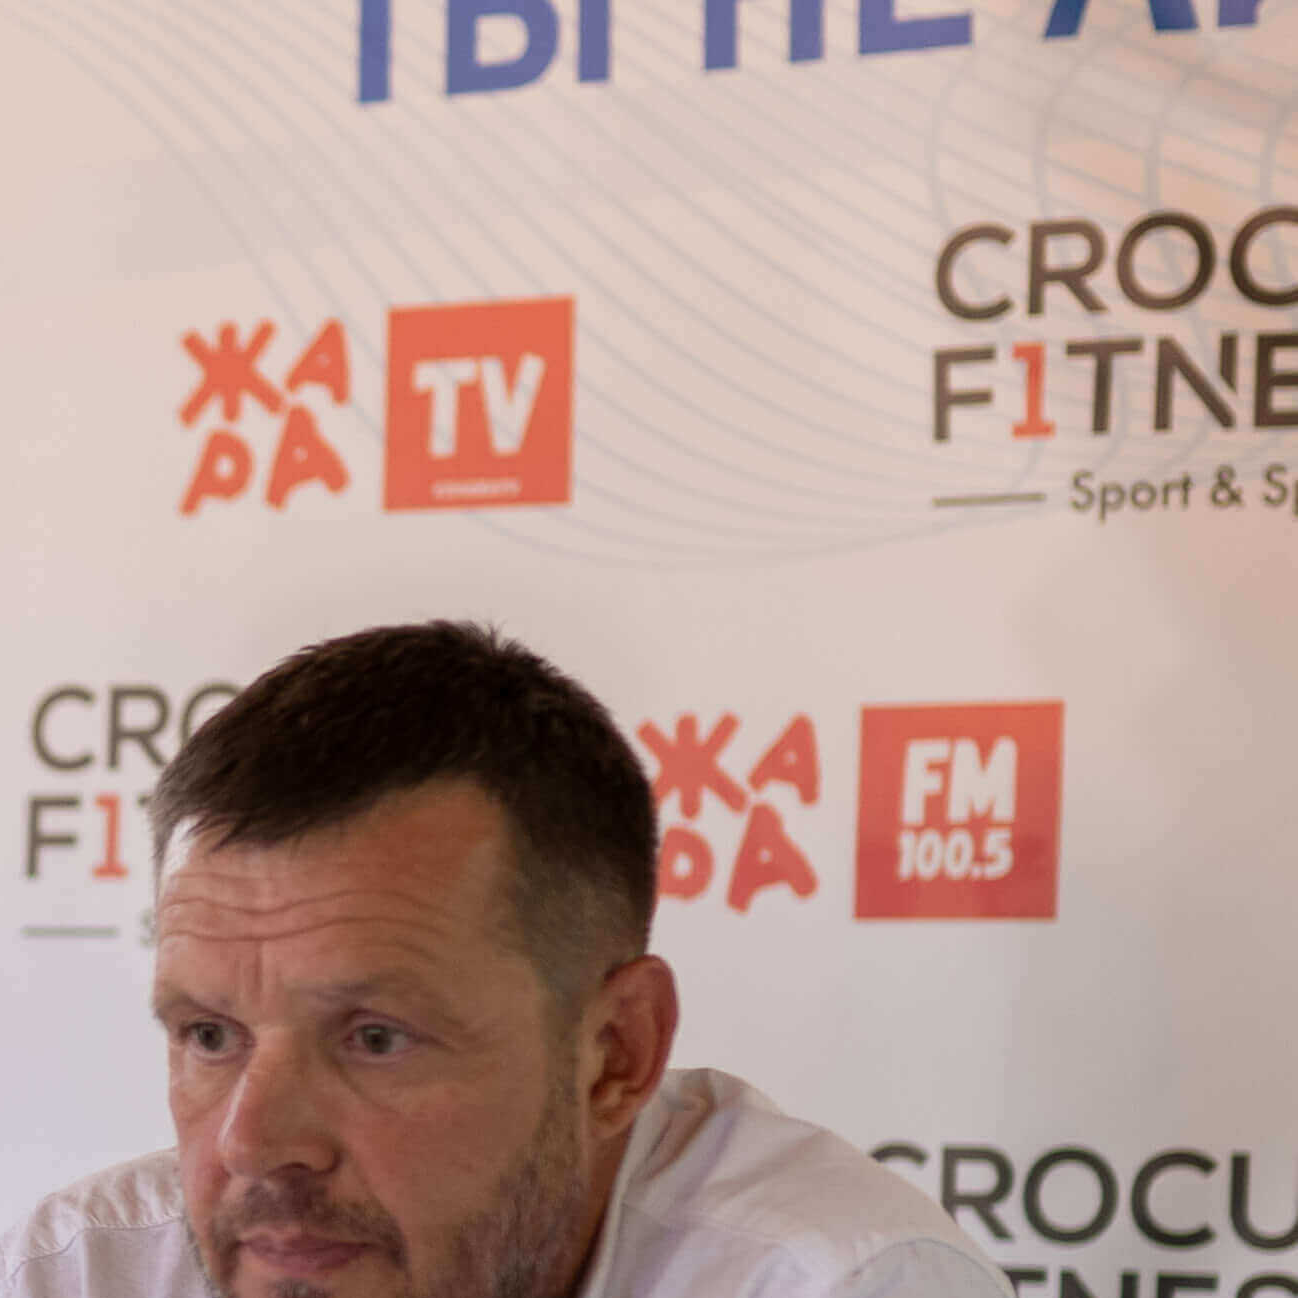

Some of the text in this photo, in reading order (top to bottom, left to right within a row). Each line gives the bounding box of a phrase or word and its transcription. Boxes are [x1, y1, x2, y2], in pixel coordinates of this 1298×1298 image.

[412, 352, 547, 459] TV
[1070, 470, 1192, 524] Sport
[1210, 464, 1243, 508] &
[903, 736, 1018, 825] FM
[898, 828, 1014, 881] 100.5
